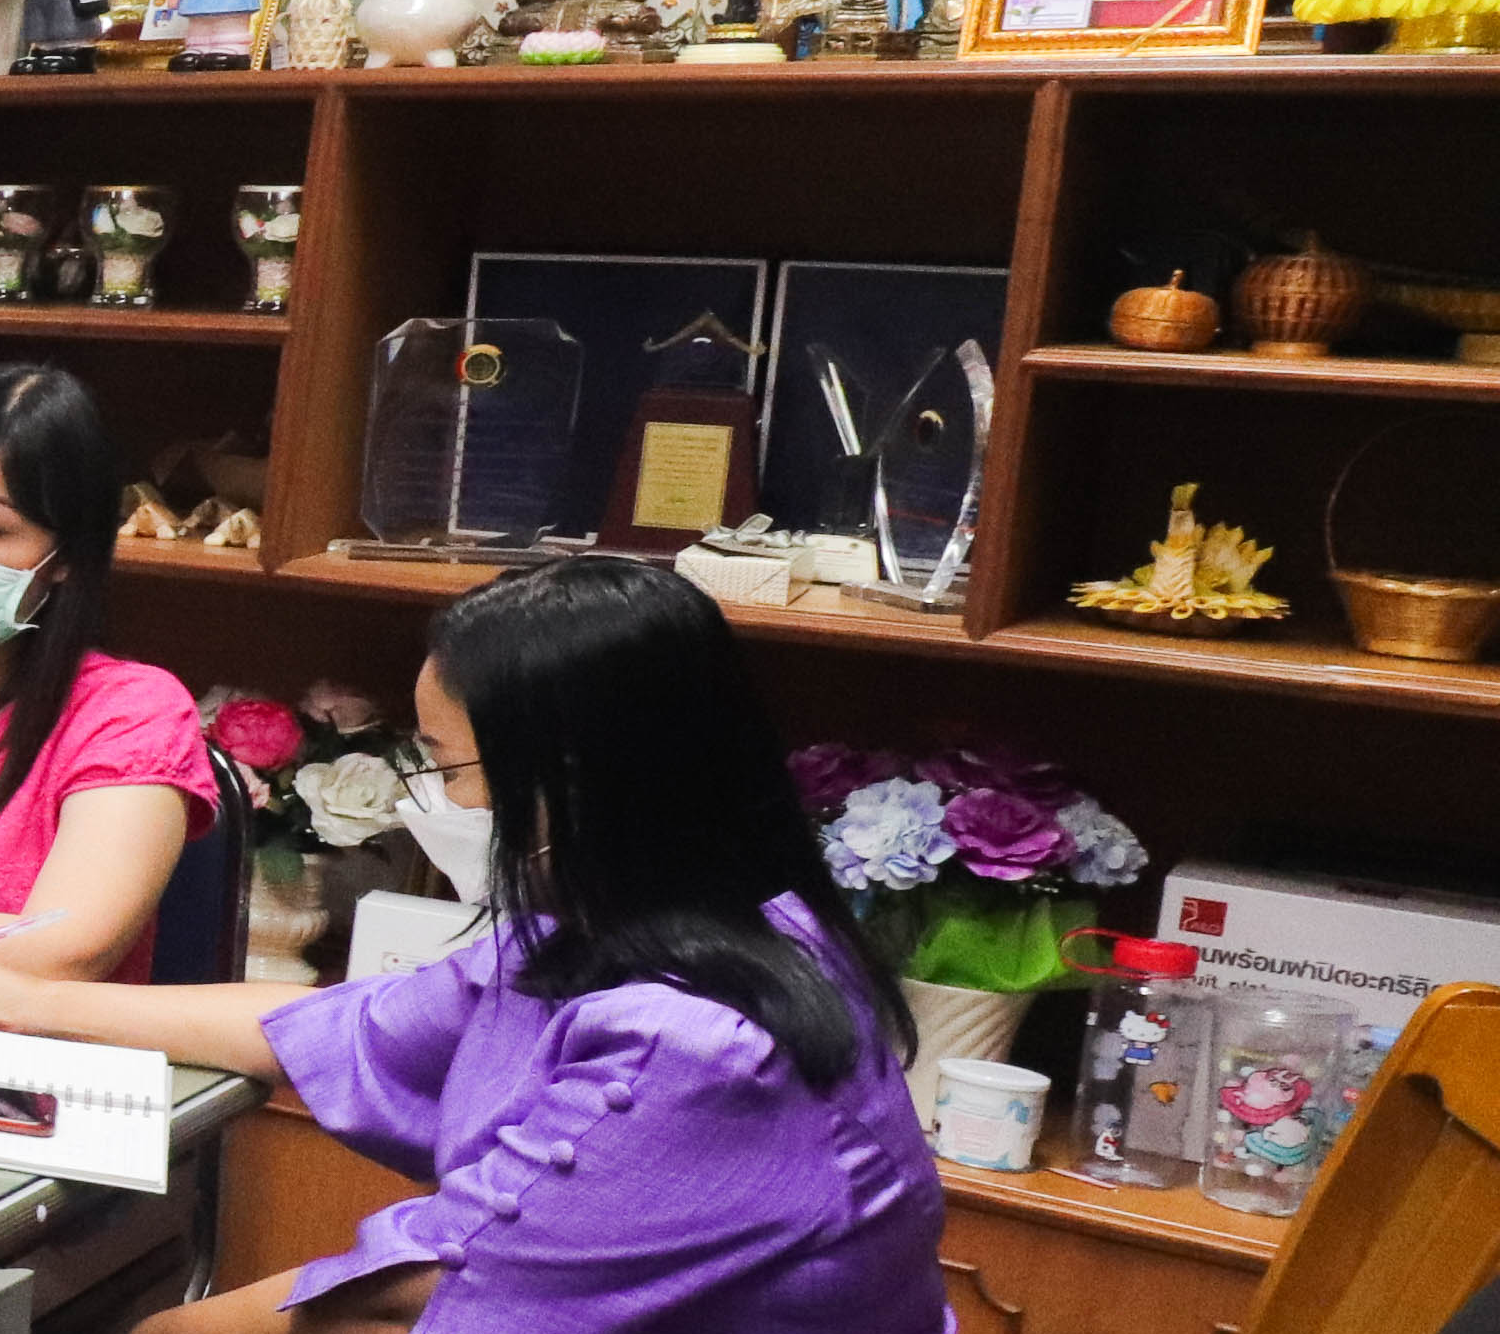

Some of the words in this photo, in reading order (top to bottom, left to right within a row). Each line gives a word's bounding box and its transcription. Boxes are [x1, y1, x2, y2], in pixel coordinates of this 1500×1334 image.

[1190, 945, 1442, 999] นพร้อมฝาปิดอะคริลิ
